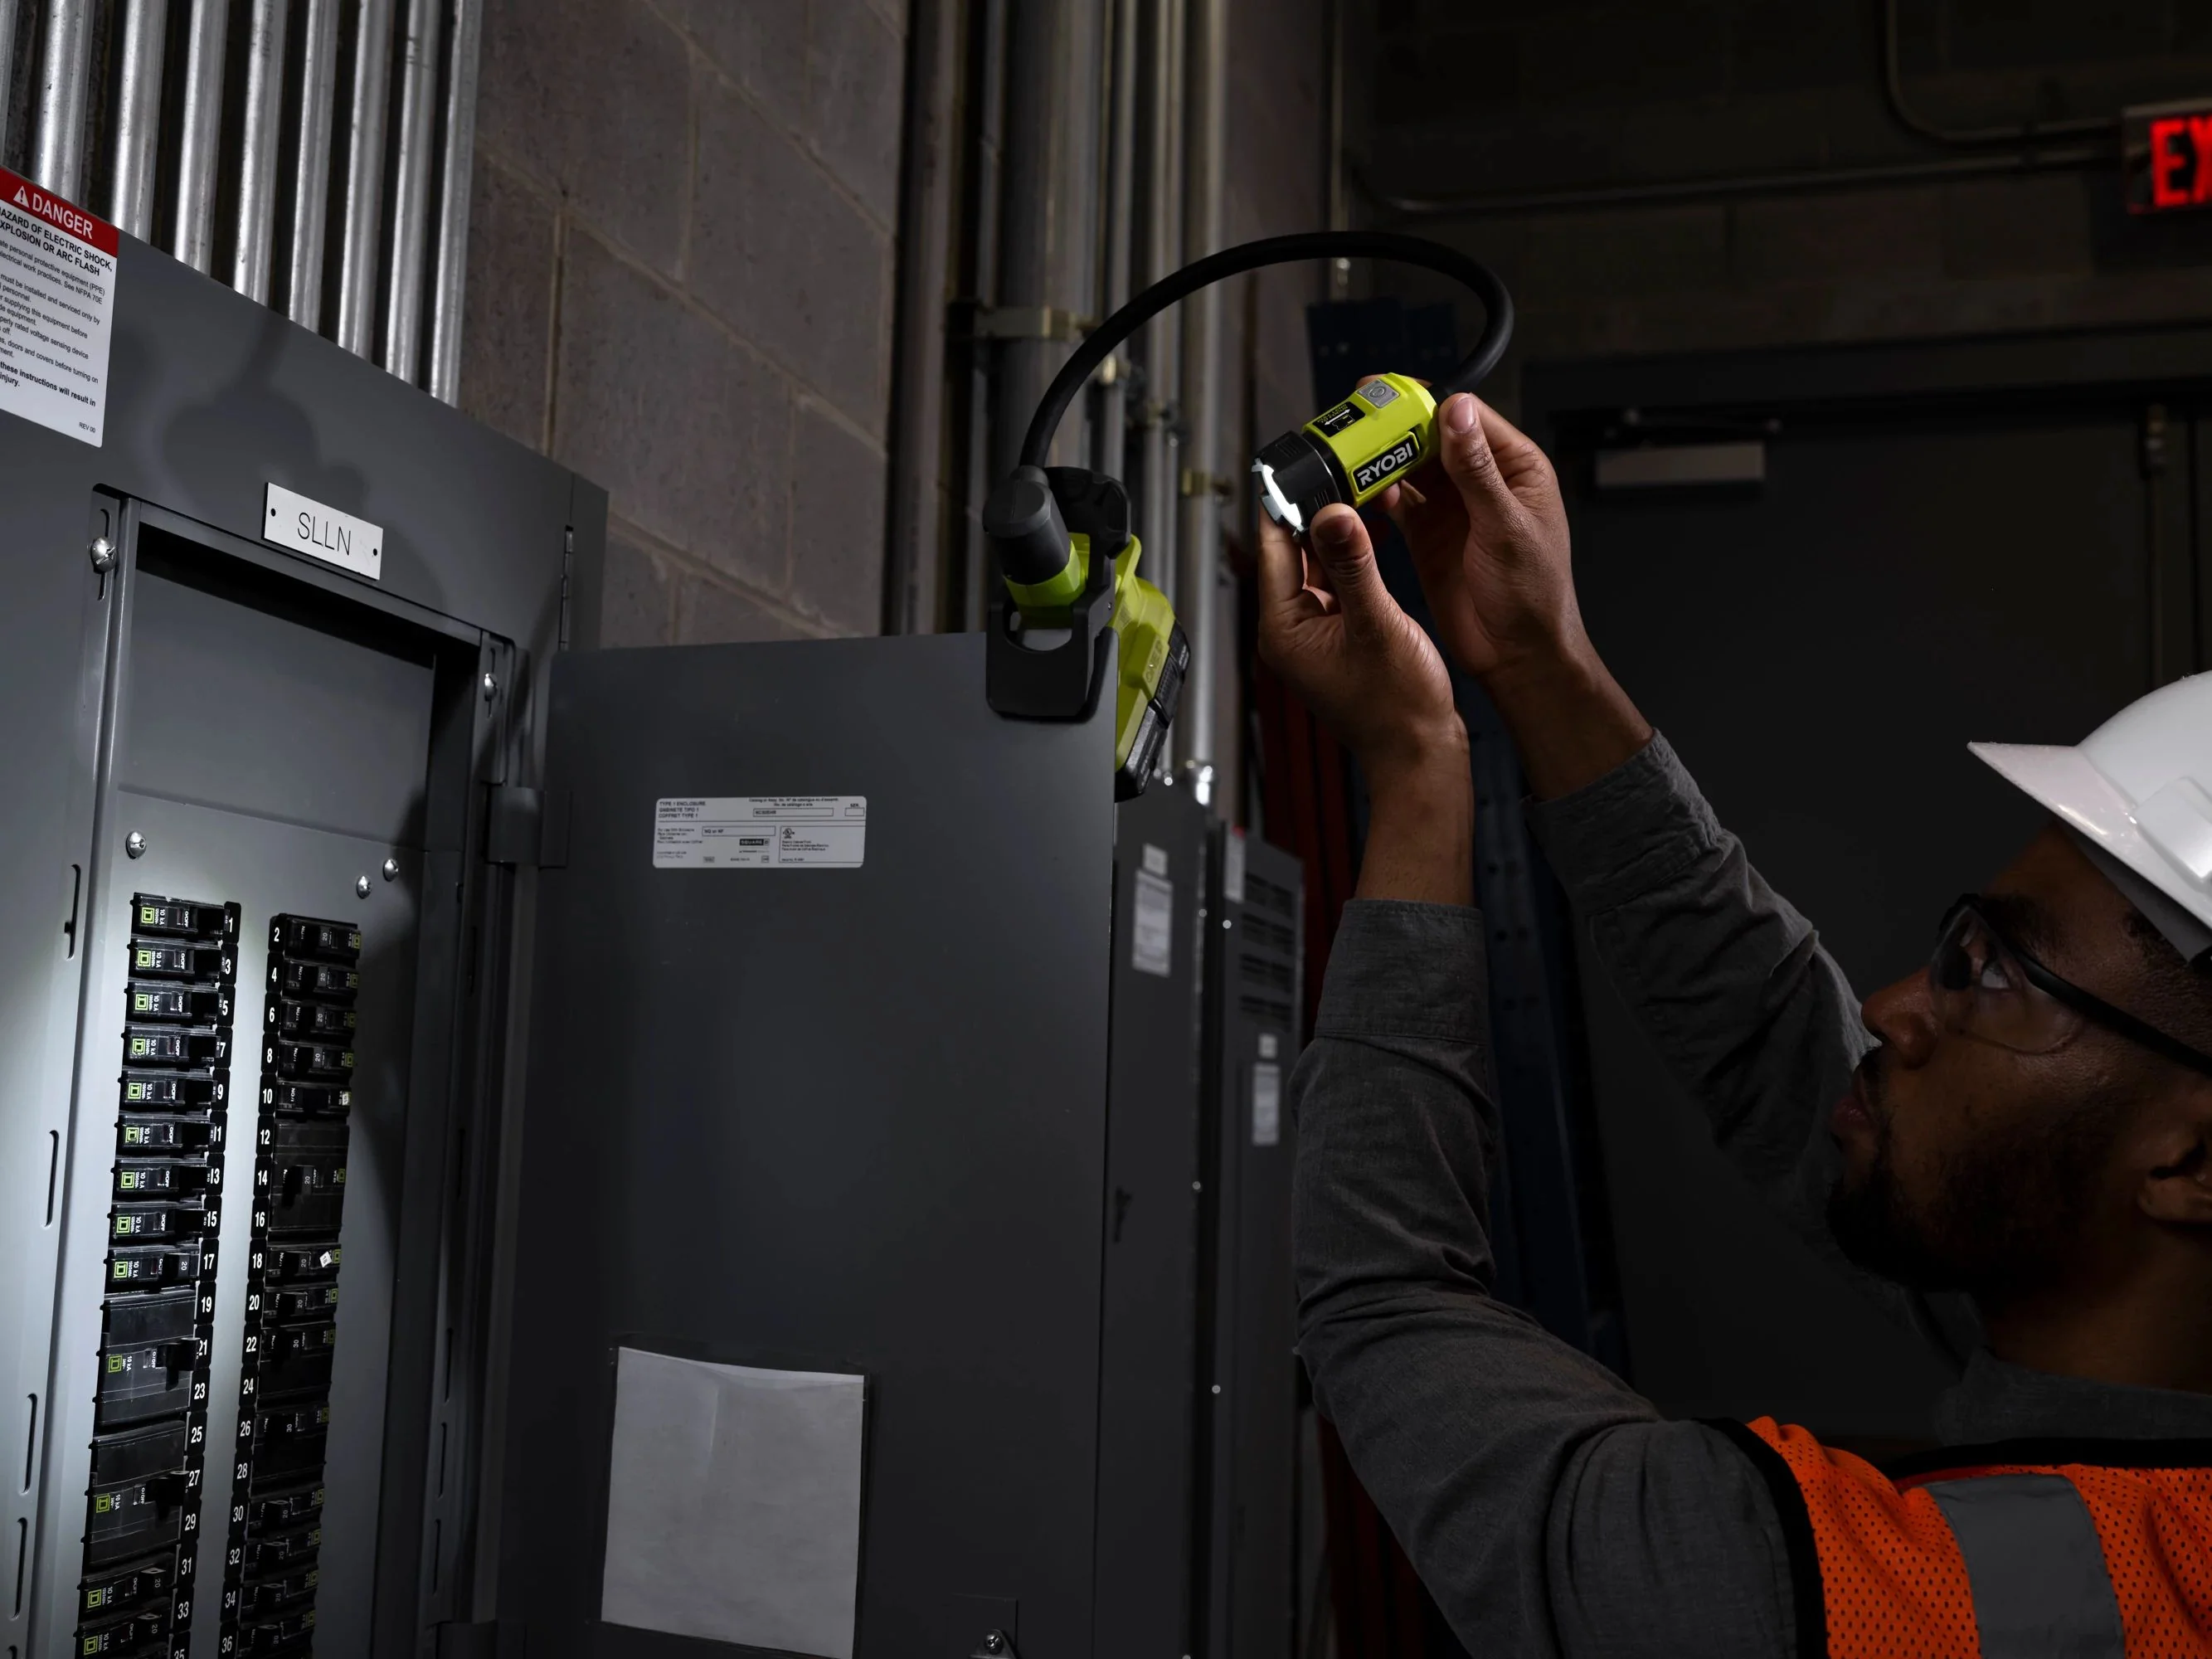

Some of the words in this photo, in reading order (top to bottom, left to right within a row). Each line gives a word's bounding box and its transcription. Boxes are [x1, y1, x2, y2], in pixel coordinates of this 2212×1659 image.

[32, 192, 93, 240] DANGER
[32, 224, 42, 235] OF
[44, 230, 82, 255] ELECTRIC
[84, 250, 112, 272] SHOCK,
[43, 241, 55, 254] OR
[56, 249, 73, 263] ARC
[75, 258, 100, 276] FLASH
[9, 245, 33, 260] personal
[34, 256, 60, 274] protective
[61, 270, 89, 288] equipment
[90, 282, 105, 296] (PPE)
[23, 262, 36, 273] work
[37, 269, 62, 286] practices.
[64, 281, 75, 291] See
[75, 286, 91, 299] NFPA
[92, 294, 102, 304] 70E
[1, 273, 14, 285] must
[16, 280, 22, 288] be
[24, 283, 46, 299] installed
[47, 294, 57, 304] and
[59, 300, 80, 315] serviced
[81, 312, 93, 322] only
[94, 316, 100, 325] by
[2, 285, 32, 302] personnel.
[4, 296, 31, 314] supplying
[32, 308, 41, 318] this
[42, 314, 70, 331] equipment
[70, 326, 88, 339] before
[7, 308, 36, 326] equipment.
[14, 321, 29, 333] rated
[30, 328, 50, 343] voltage
[51, 338, 70, 353] sensing
[72, 348, 89, 359] device
[7, 339, 23, 352] doors
[25, 348, 35, 357] and
[36, 353, 54, 365] covers
[55, 359, 72, 372] before
[73, 367, 90, 382] turning
[0, 371, 20, 387] injury.
[0, 361, 18, 374] these
[19, 368, 57, 391] instructions
[59, 385, 70, 396] will
[70, 391, 89, 405] result
[90, 398, 96, 406] in
[79, 421, 89, 431] REV
[1357, 443, 1412, 487] RYOBI
[297, 512, 351, 556] SLLN
[159, 917, 165, 925] kA
[228, 917, 233, 932] 1
[274, 927, 280, 942] 2
[322, 932, 328, 941] 20
[156, 960, 162, 968] kA
[225, 959, 231, 975] 3
[271, 967, 277, 982] 4
[320, 973, 326, 981] 20
[153, 1003, 159, 1011] kA
[221, 1000, 228, 1015] 5
[269, 1006, 275, 1023] 6
[318, 1014, 323, 1022] 20
[150, 1047, 156, 1056] kA
[220, 1042, 226, 1058] 7
[266, 1048, 273, 1063] 8
[315, 1053, 320, 1062] 20
[146, 1092, 153, 1100] kA
[217, 1083, 224, 1100] 9
[262, 1088, 273, 1104] 10
[143, 1136, 150, 1144] kA
[260, 1129, 270, 1145] 12
[139, 1180, 145, 1189] kA
[210, 1168, 220, 1185] 13
[257, 1170, 268, 1185] 14
[304, 1175, 310, 1184] 20
[207, 1211, 217, 1228] 15
[255, 1211, 265, 1228] 16
[135, 1225, 141, 1233] kA
[182, 1261, 187, 1271] 20
[203, 1253, 215, 1270] 17
[252, 1253, 262, 1268] 18
[301, 1258, 306, 1267] 20
[133, 1269, 139, 1277] kA
[201, 1296, 212, 1313] 19
[248, 1294, 260, 1311] 20
[297, 1299, 303, 1308] 20
[198, 1339, 207, 1356] 21
[246, 1335, 257, 1353] 22
[293, 1339, 299, 1348] 30
[194, 1382, 205, 1399] 23
[242, 1378, 254, 1394] 24
[191, 1426, 202, 1443] 25
[240, 1420, 251, 1437] 26
[286, 1423, 292, 1433] 30
[188, 1469, 200, 1487] 27
[236, 1462, 248, 1480] 28
[184, 1513, 196, 1531] 29
[232, 1505, 244, 1522] 30
[229, 1548, 241, 1565] 32
[181, 1556, 192, 1575] 31
[154, 1578, 161, 1588] 20
[225, 1590, 236, 1608] 34
[177, 1600, 189, 1619] 33
[152, 1624, 158, 1634] 20
[221, 1635, 232, 1653] 36
